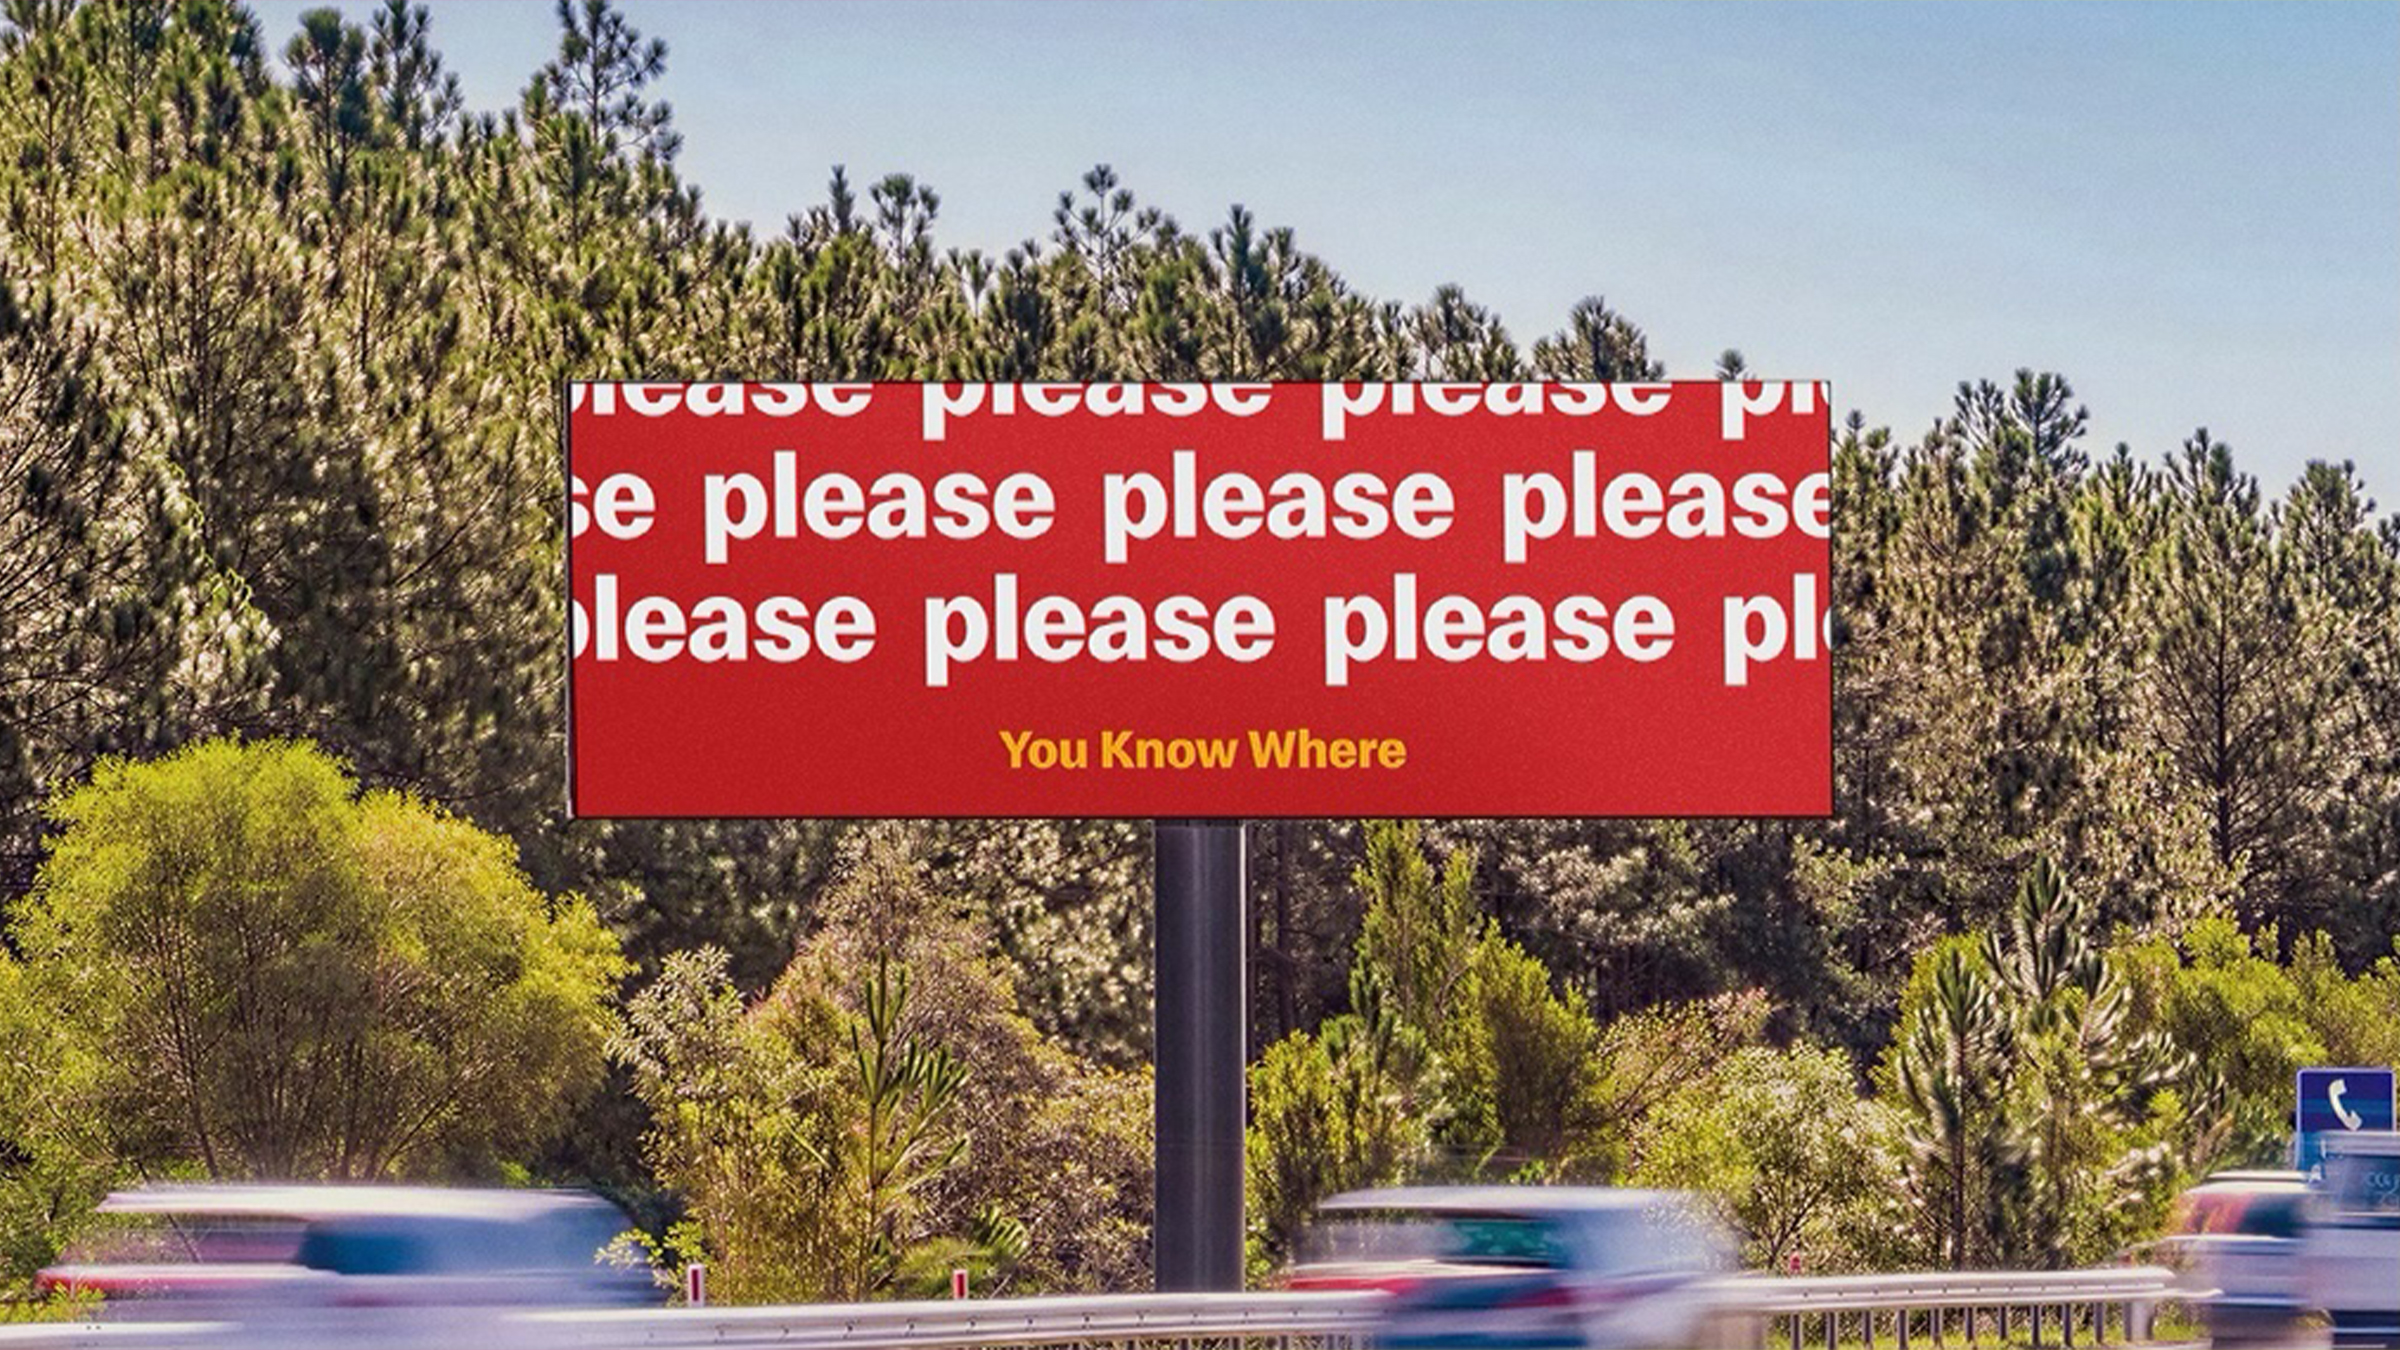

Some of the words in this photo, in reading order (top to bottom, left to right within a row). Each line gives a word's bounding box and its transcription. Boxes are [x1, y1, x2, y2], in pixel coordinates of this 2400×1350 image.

[572, 382, 873, 417] ease
[704, 450, 1055, 564] please
[1104, 450, 1455, 564] please
[1503, 449, 1831, 564] please
[573, 573, 876, 663] lease
[925, 573, 1276, 687] please
[1324, 572, 1675, 687] please
[1723, 572, 1831, 687] pl
[1000, 731, 1087, 768] You
[1101, 731, 1238, 768] Know
[1248, 728, 1406, 768] Where
